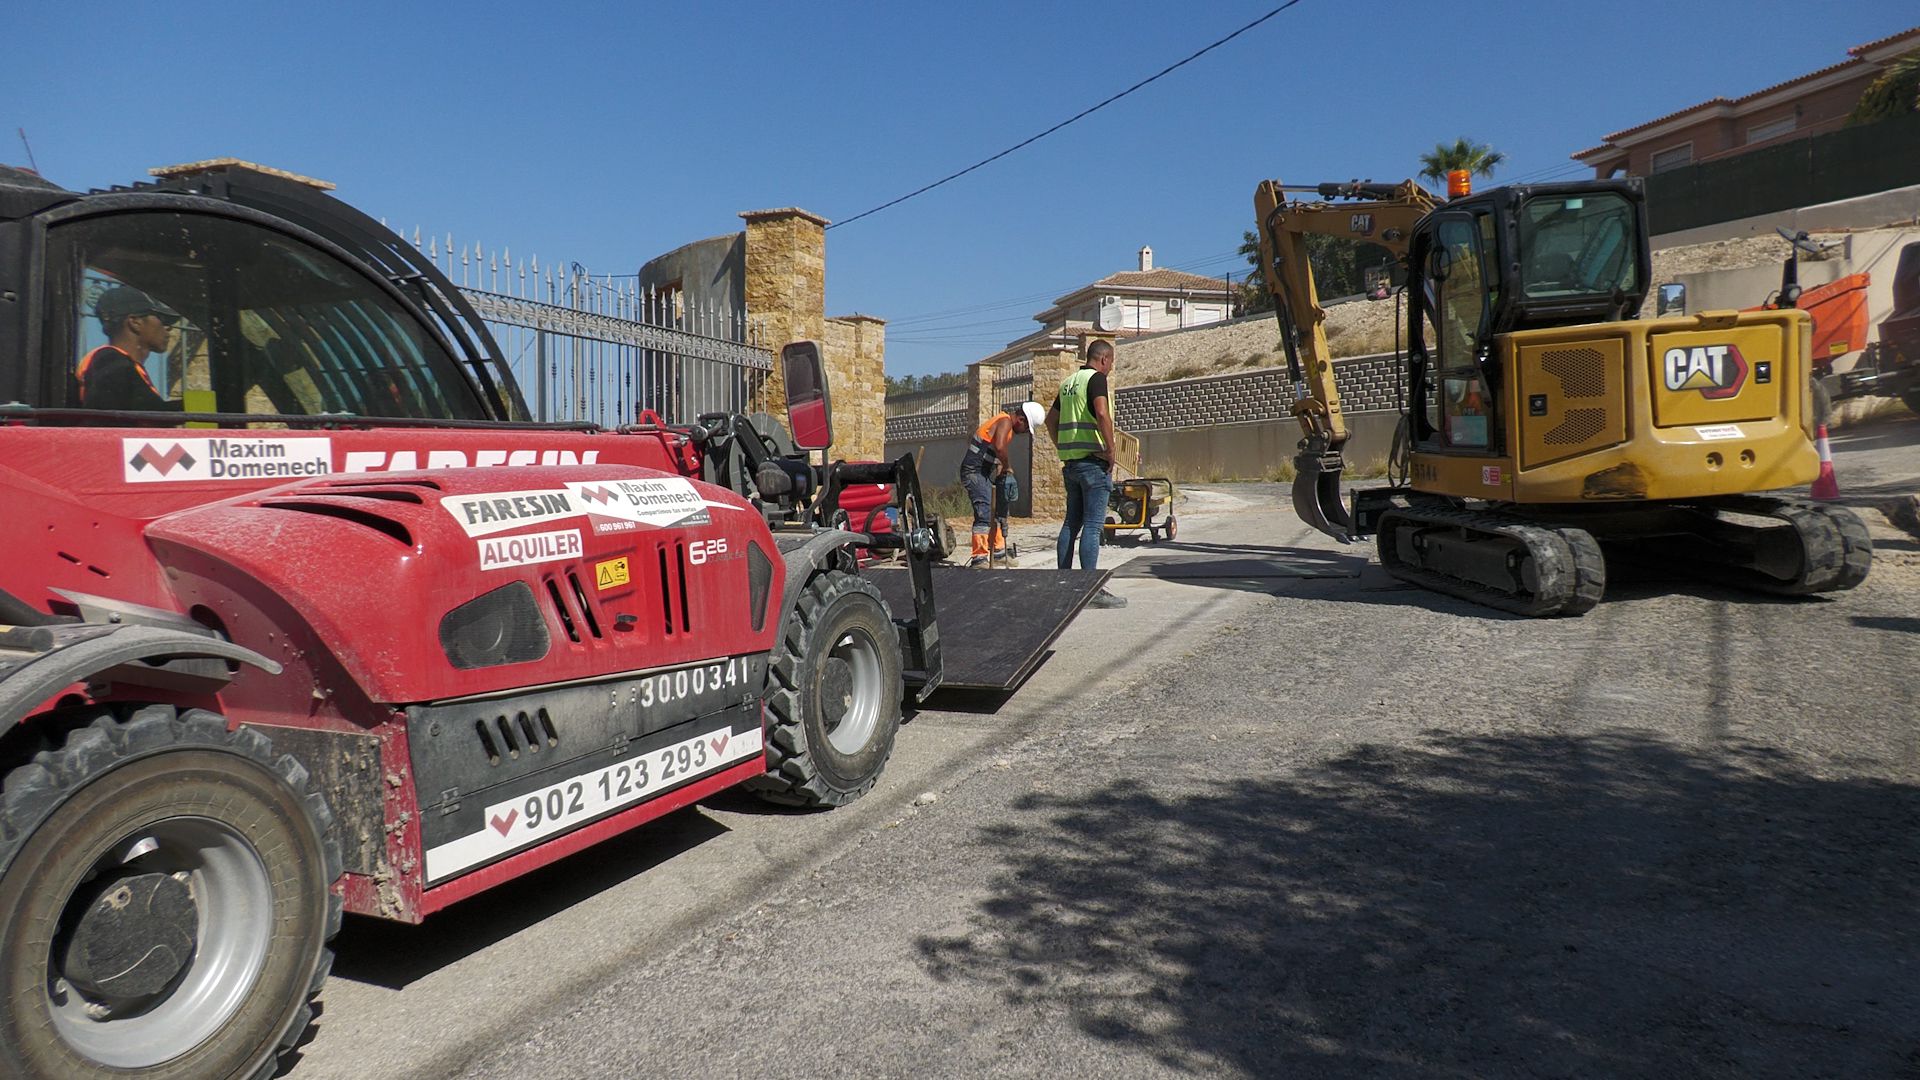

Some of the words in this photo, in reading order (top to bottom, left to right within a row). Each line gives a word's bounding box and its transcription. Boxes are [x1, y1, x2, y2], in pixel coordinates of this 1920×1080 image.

[1351, 214, 1371, 232] CAT
[1665, 345, 1728, 390] CAT
[208, 439, 286, 458] Maxim
[210, 457, 329, 478] Domenech
[616, 481, 667, 494] Maxim
[626, 490, 701, 506] Domenech
[462, 493, 572, 525] FARESIN
[600, 523, 613, 532] 600
[613, 522, 625, 531] 961
[624, 521, 636, 530] 961
[483, 533, 580, 566] ALQUILER
[525, 781, 584, 829] 902
[598, 759, 650, 801] 123
[660, 739, 707, 780] 293
